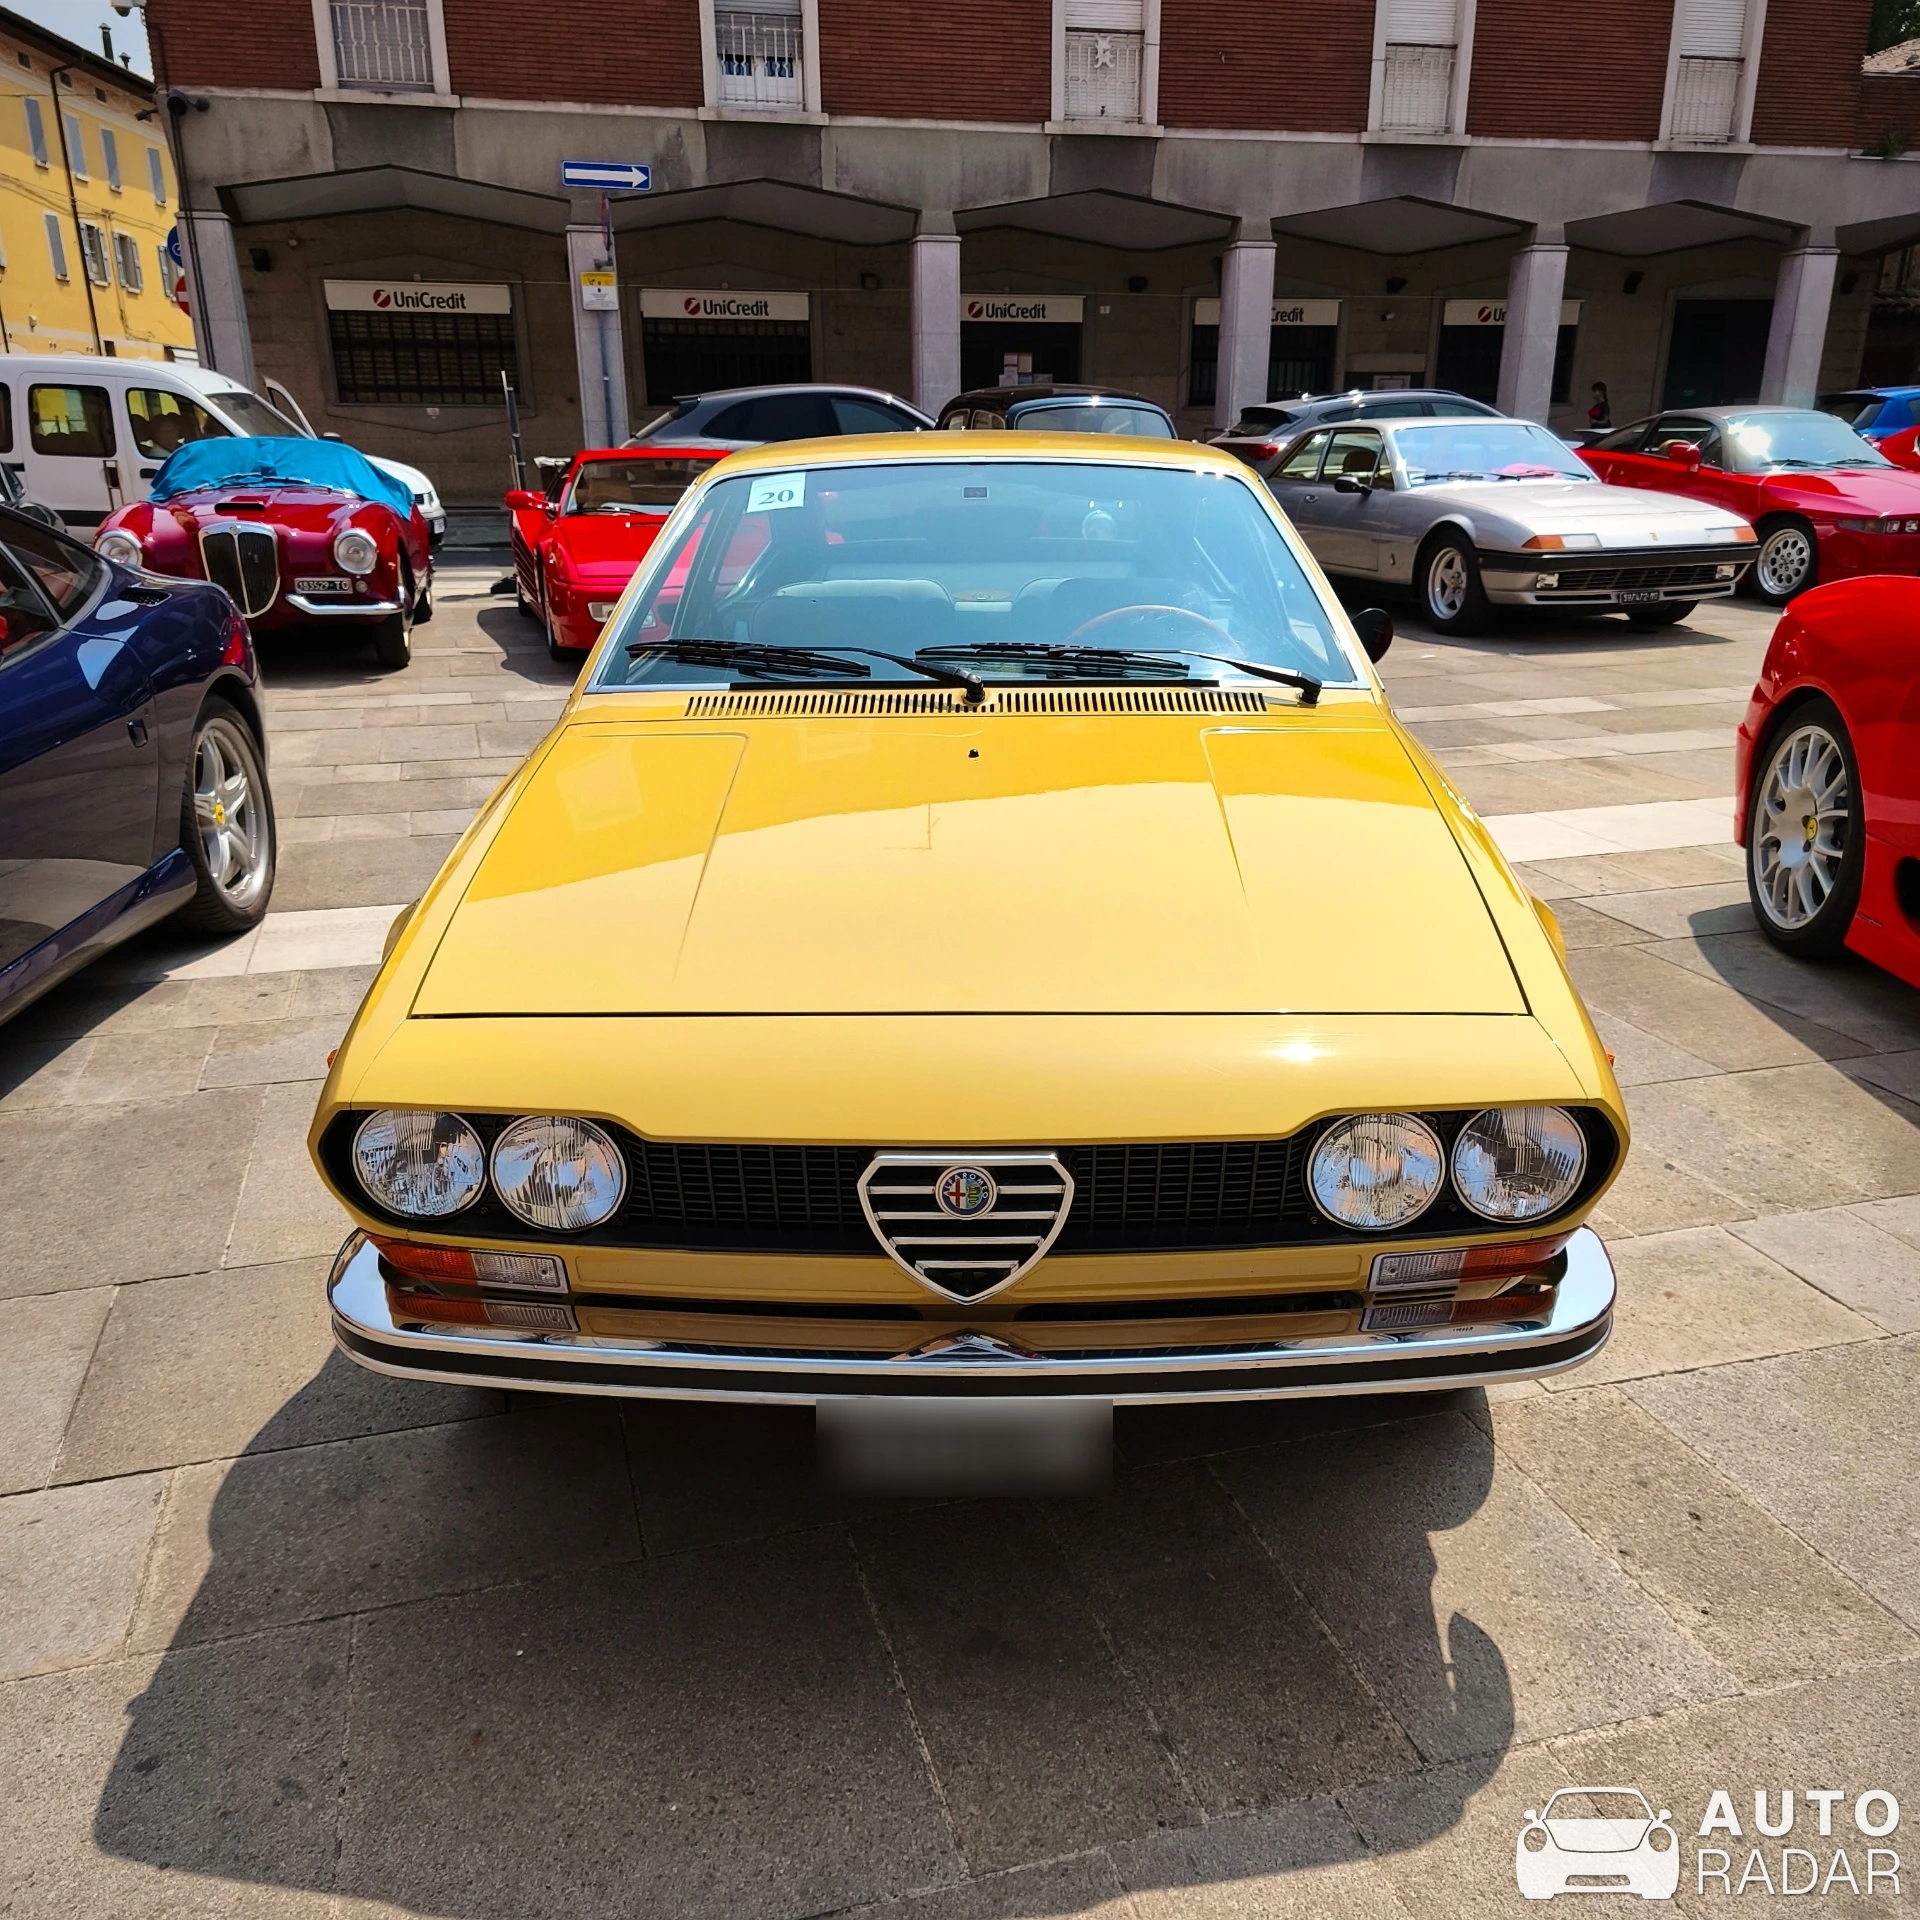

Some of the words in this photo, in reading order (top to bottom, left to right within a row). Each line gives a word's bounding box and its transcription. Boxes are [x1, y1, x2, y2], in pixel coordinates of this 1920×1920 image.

[393, 291, 467, 310] UniCredit
[703, 299, 770, 317] UniCredit
[985, 302, 1047, 319] UniCredit
[757, 489, 795, 505] 20
[943, 1174, 961, 1197] ALFA
[962, 1172, 989, 1199] ROMEO
